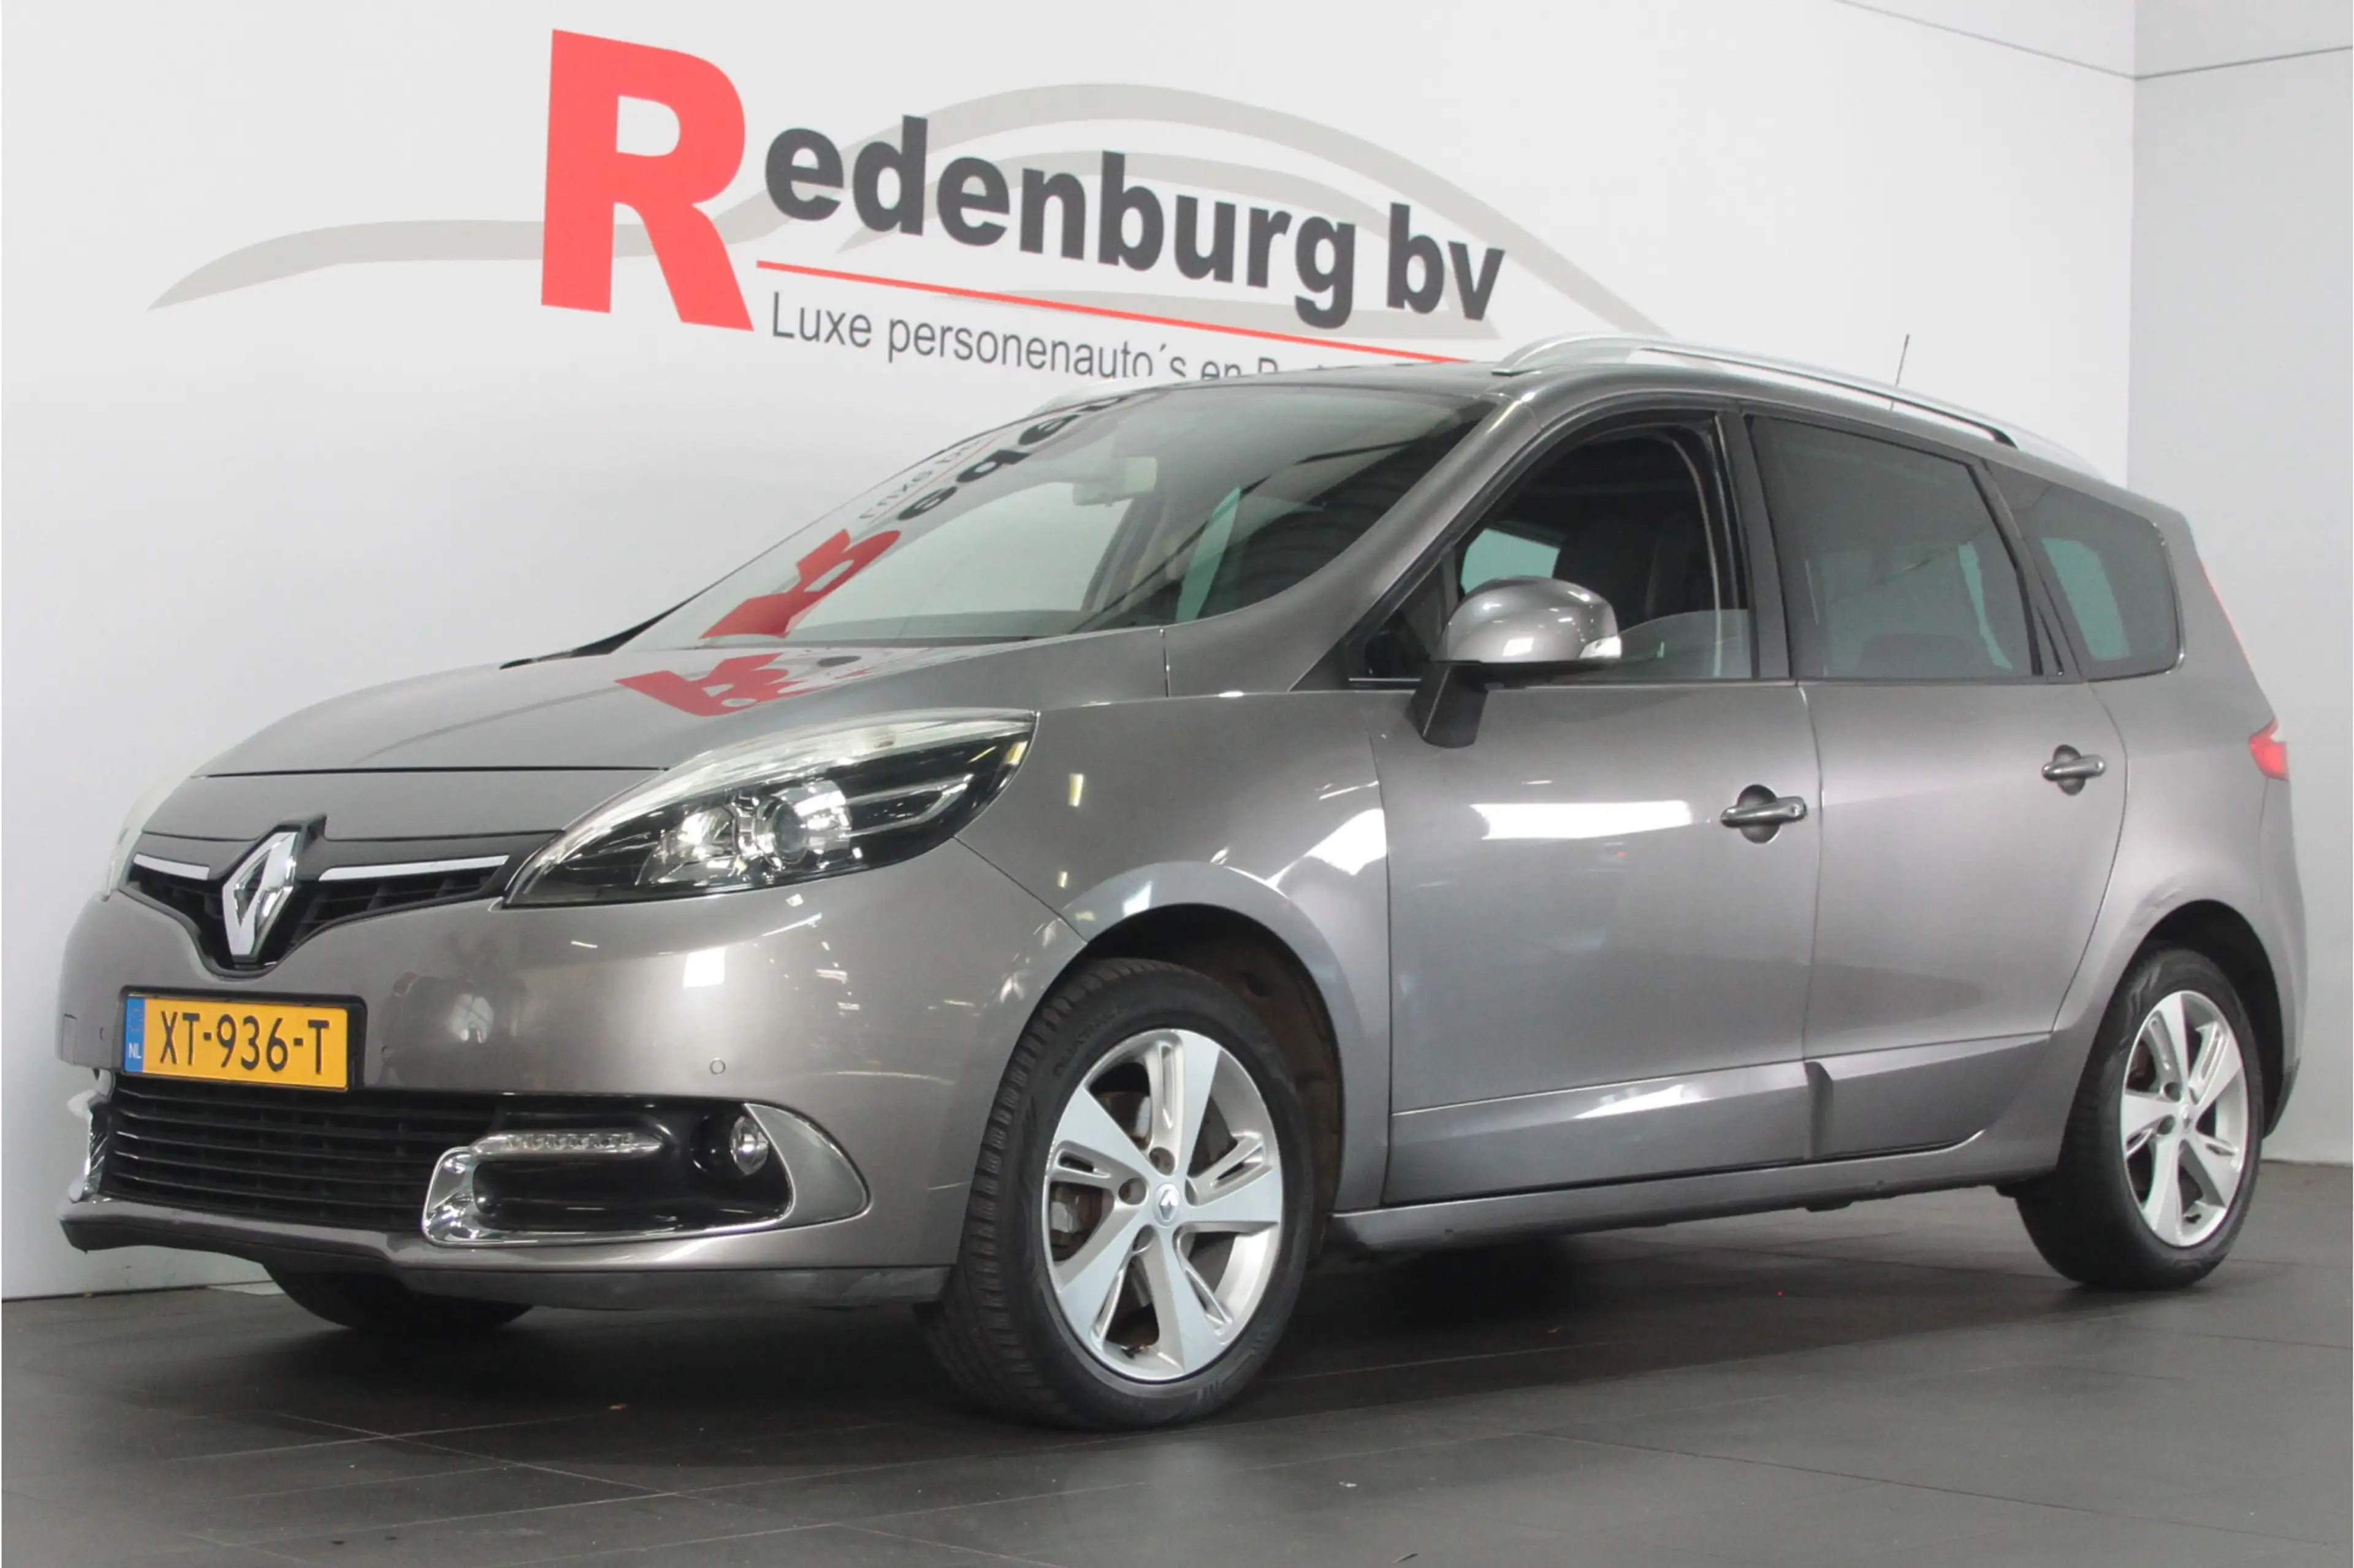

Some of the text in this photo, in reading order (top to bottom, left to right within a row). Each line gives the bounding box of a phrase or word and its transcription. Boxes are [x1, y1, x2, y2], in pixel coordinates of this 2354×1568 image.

[541, 29, 1505, 331] Redenburg bv
[772, 292, 872, 348] Luxe
[128, 1043, 142, 1059] NL
[160, 1011, 330, 1074] XT-936-T
